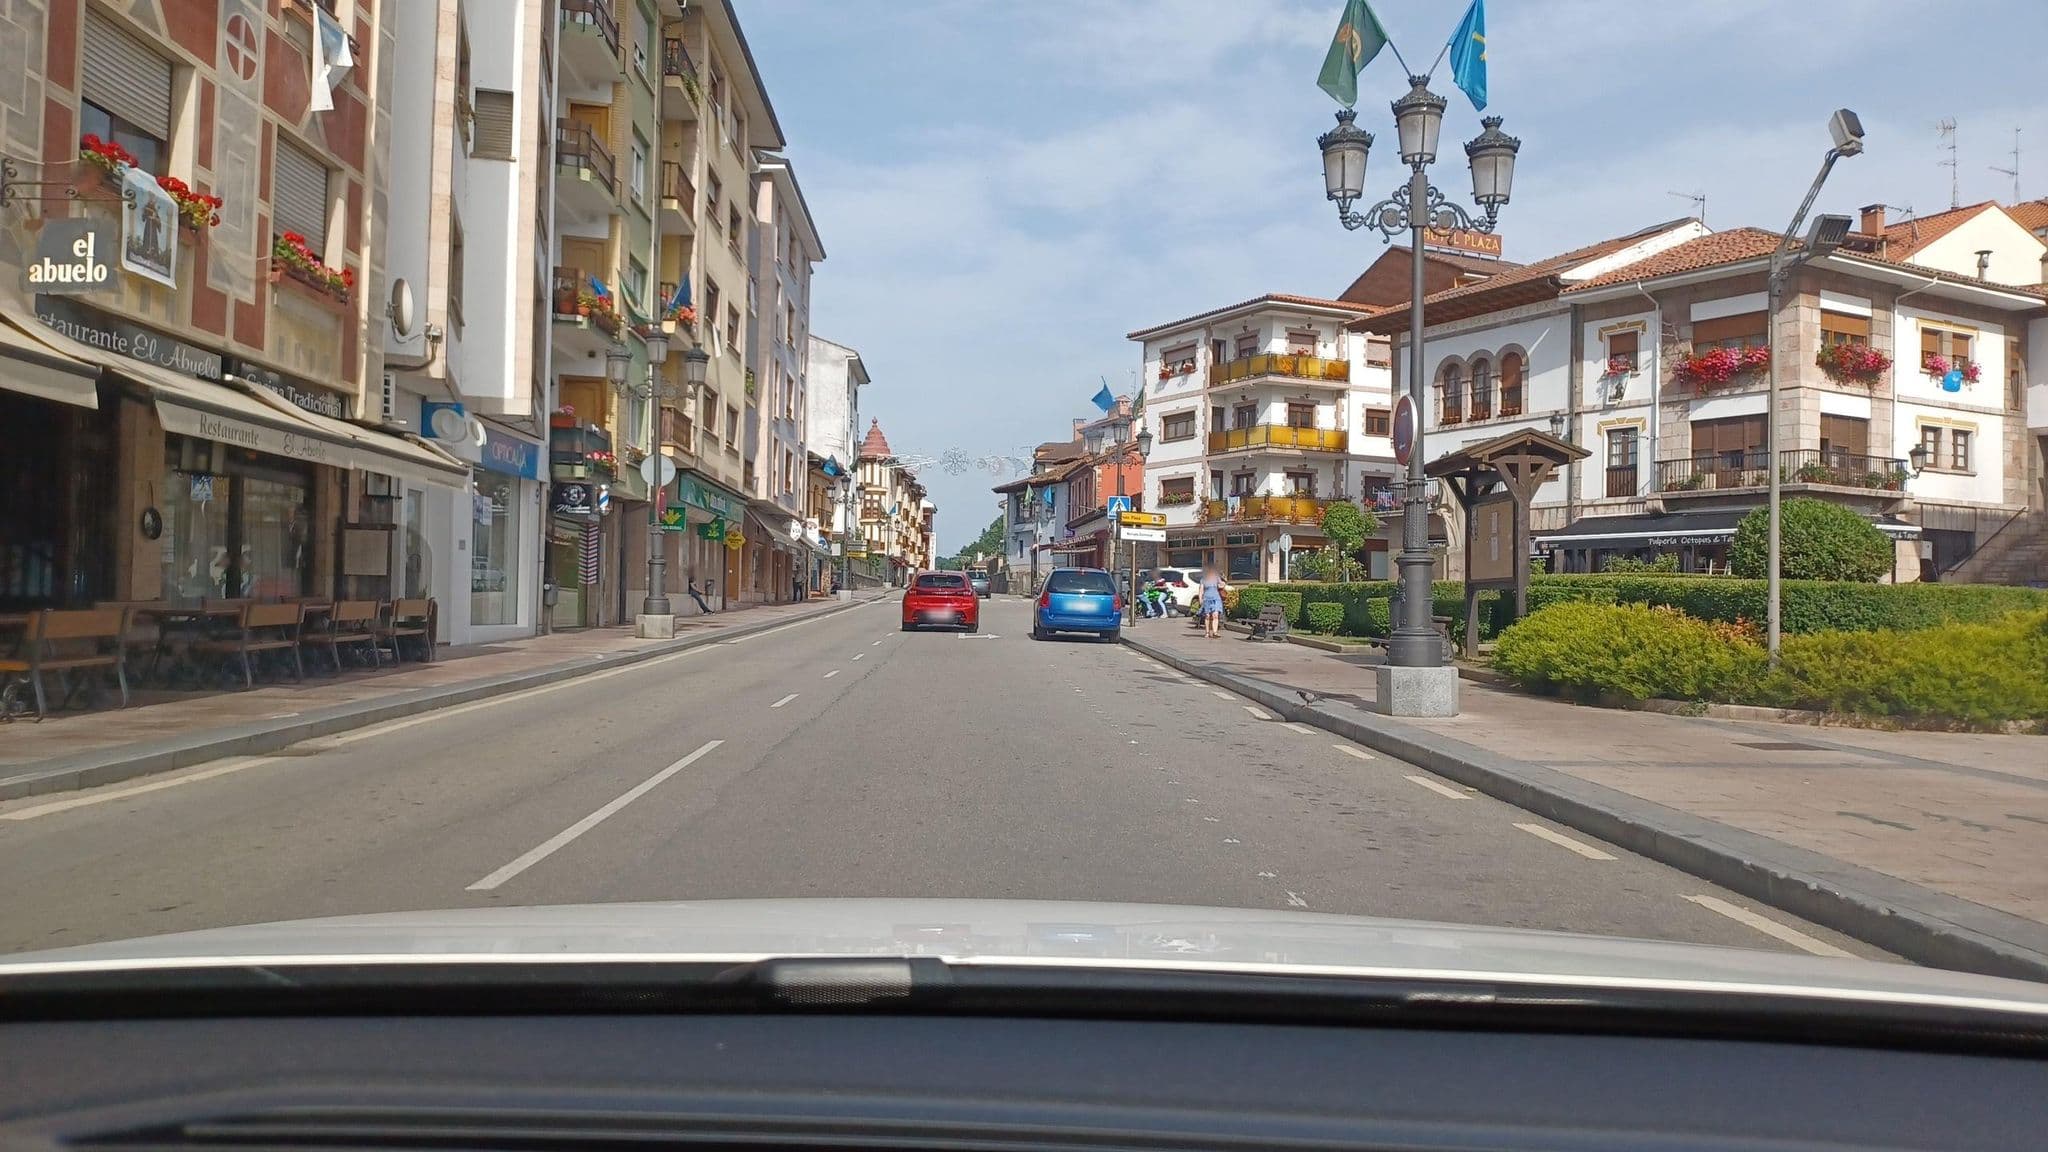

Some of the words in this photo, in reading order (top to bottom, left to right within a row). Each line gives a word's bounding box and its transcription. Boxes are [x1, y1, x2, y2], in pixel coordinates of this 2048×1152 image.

[73, 232, 95, 257] el
[1424, 227, 1459, 245] HOTL
[1464, 233, 1500, 251] PLAZA
[29, 257, 107, 283] abuelo
[34, 311, 129, 353] staurante
[132, 333, 157, 362] El
[160, 345, 219, 380] Abuelo
[287, 385, 342, 419] Tradicional
[200, 413, 260, 446] Restaurante
